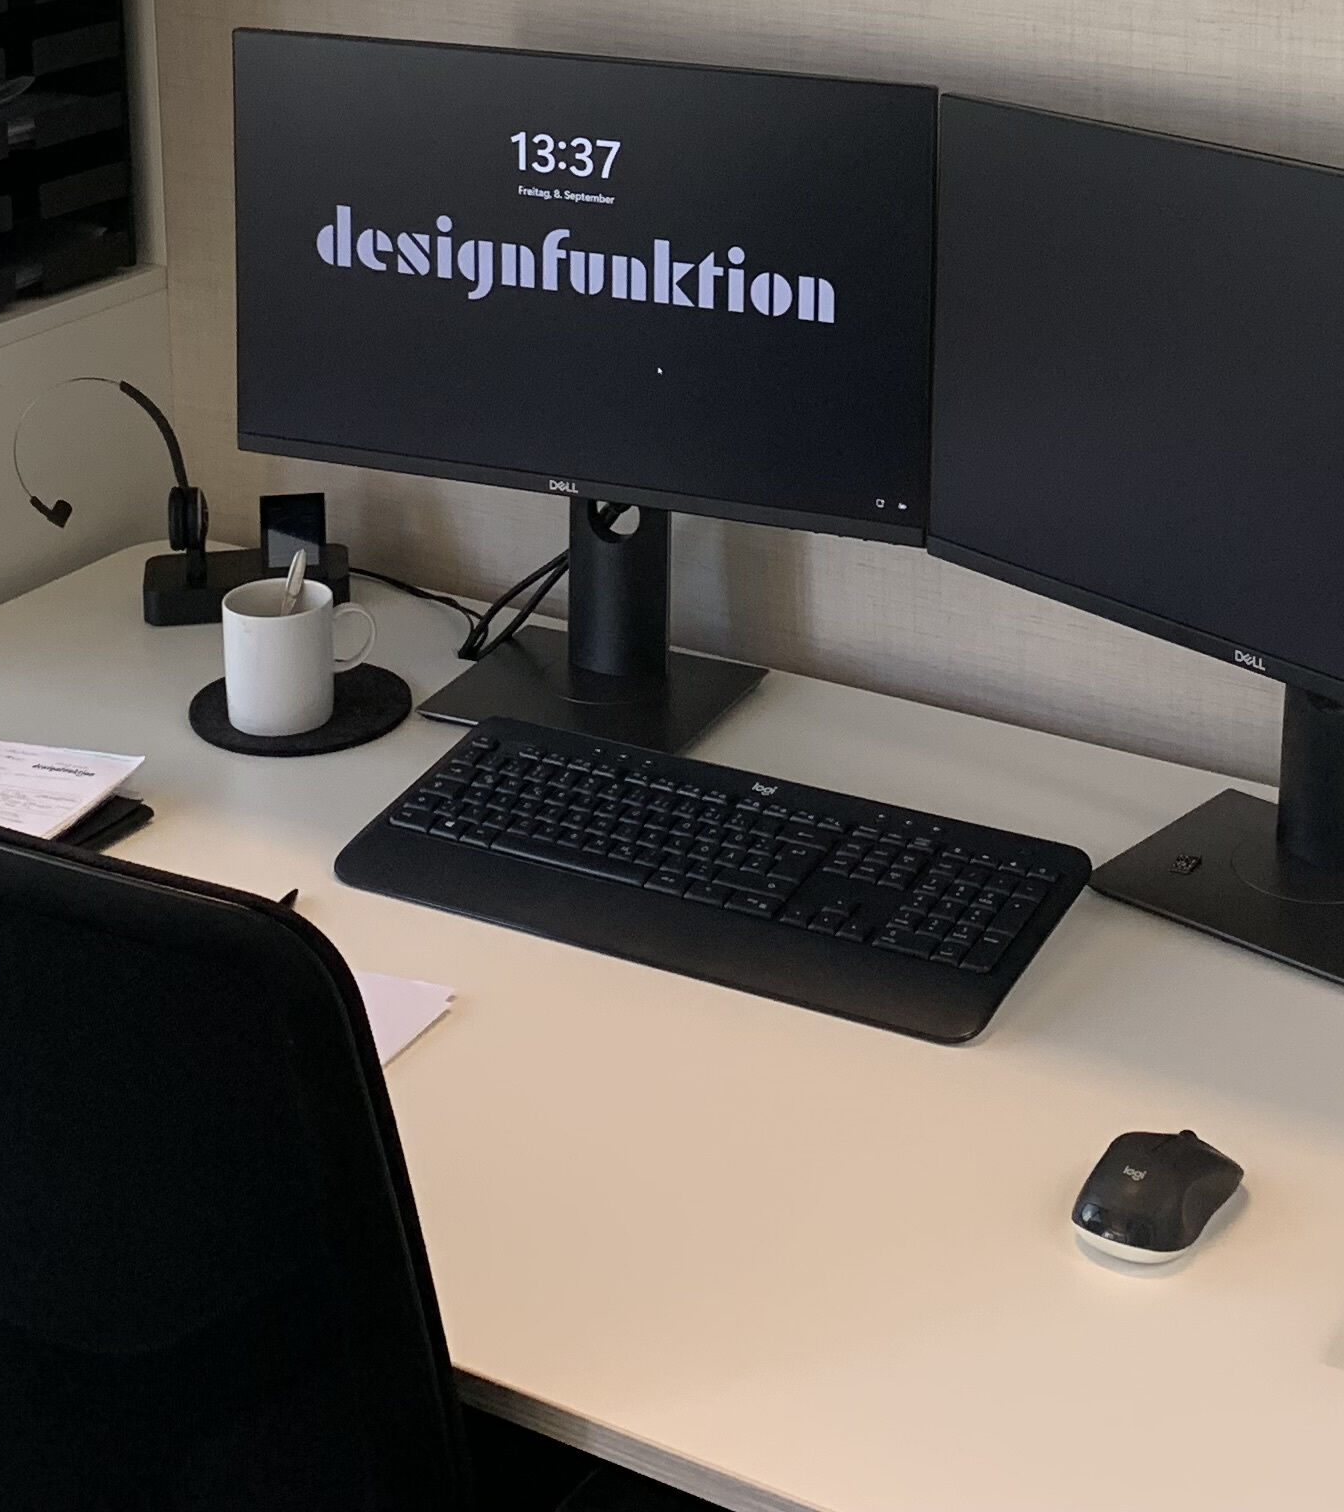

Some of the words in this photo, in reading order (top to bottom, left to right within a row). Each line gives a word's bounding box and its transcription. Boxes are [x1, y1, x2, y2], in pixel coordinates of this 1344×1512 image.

[510, 131, 621, 179] 13:37
[518, 185, 552, 200] Freitag,
[554, 189, 563, 199] 8.
[564, 190, 615, 204] September
[317, 204, 835, 324] designfunktion
[549, 479, 578, 494] DELL
[1235, 649, 1266, 671] DELL
[752, 782, 778, 796] logi
[1123, 1165, 1147, 1181] logi
